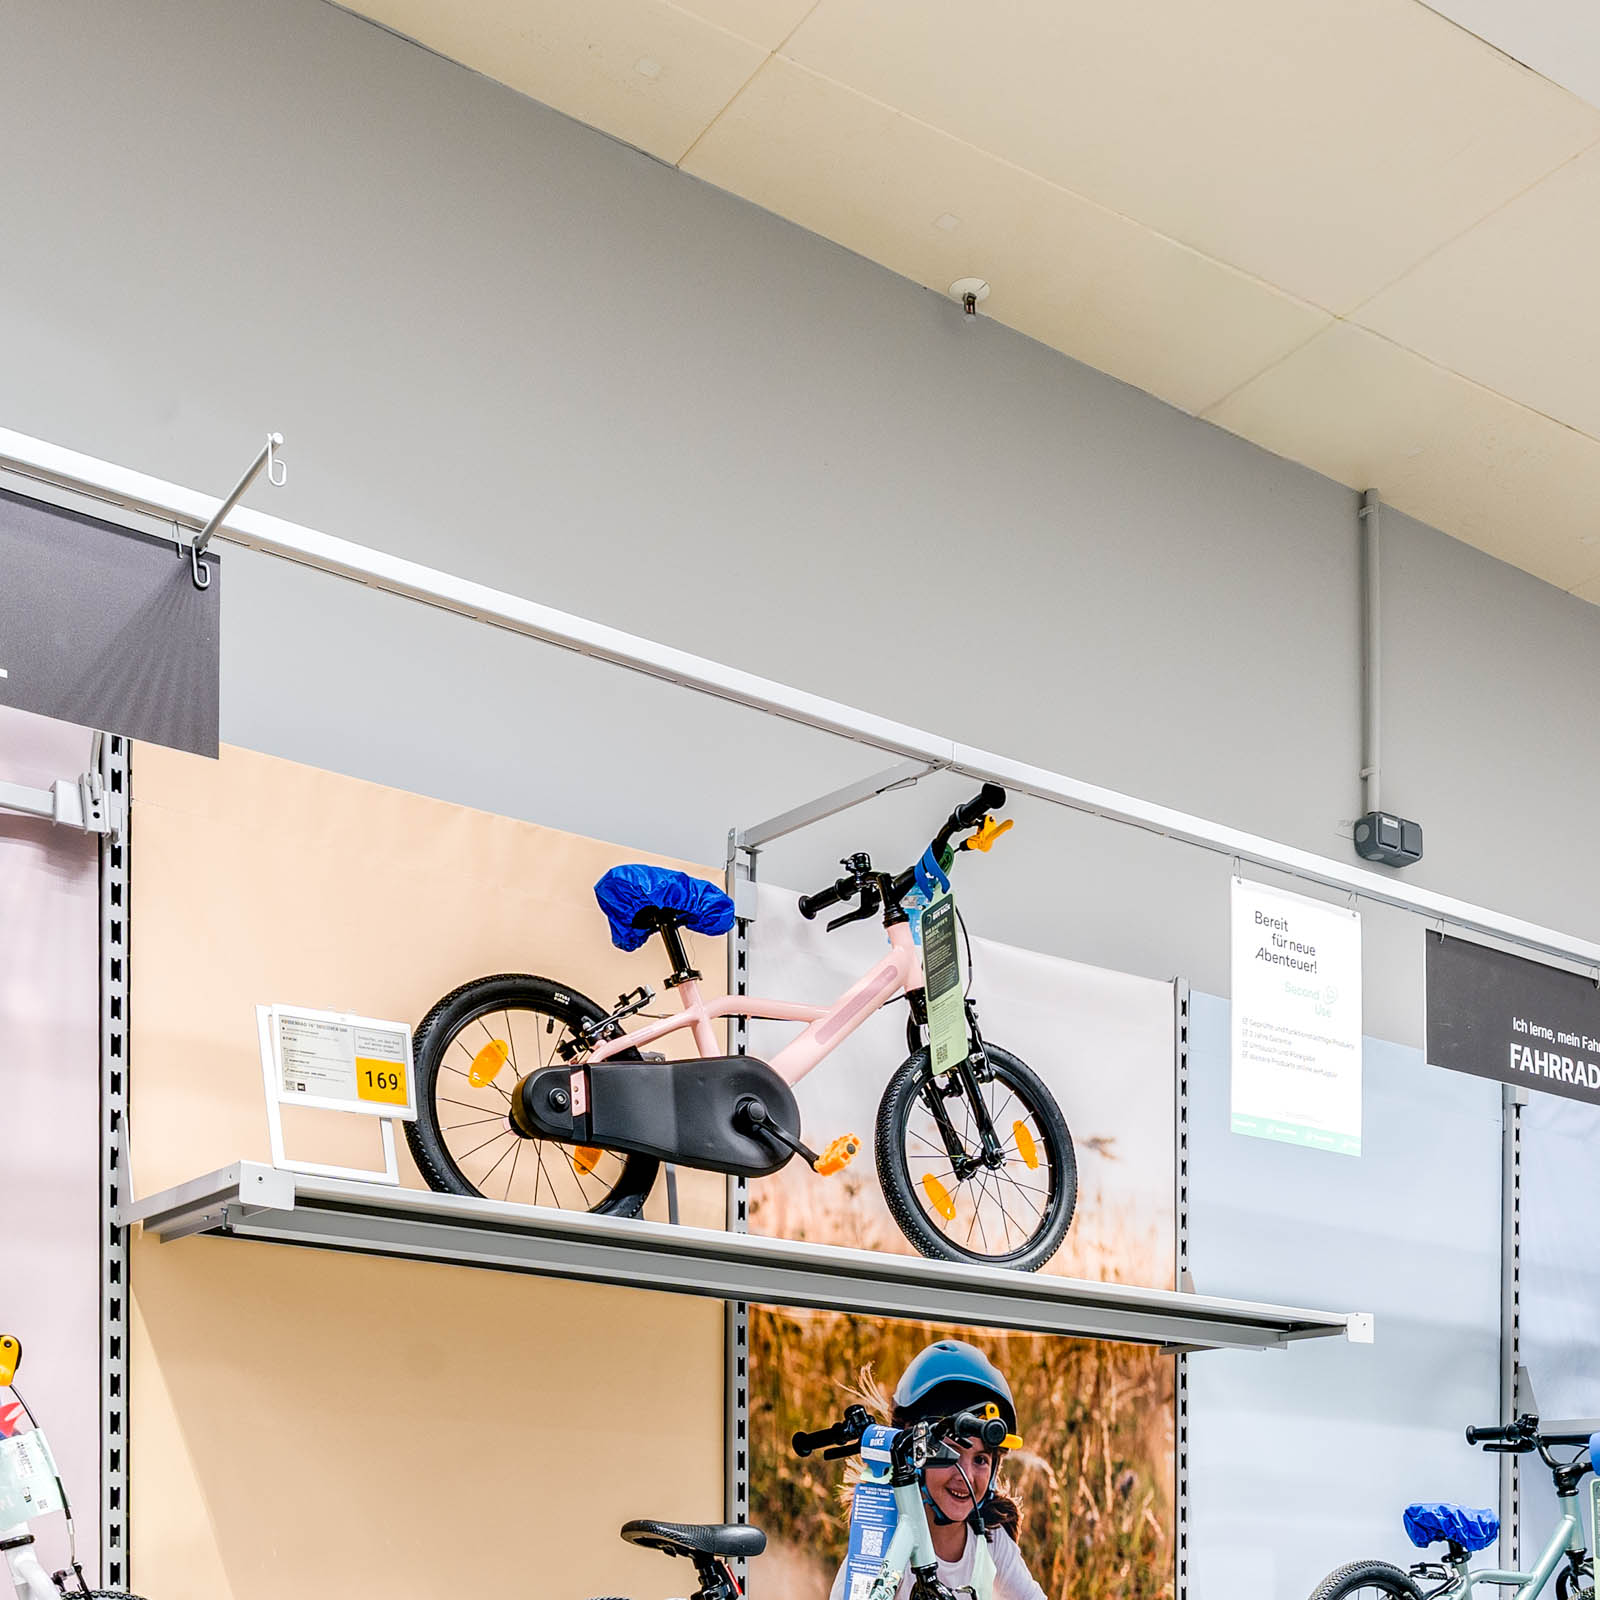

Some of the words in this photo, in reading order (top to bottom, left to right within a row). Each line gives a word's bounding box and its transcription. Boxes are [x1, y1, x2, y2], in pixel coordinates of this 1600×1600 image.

[1254, 911, 1289, 932] Bereit
[1272, 933, 1287, 949] für
[1289, 941, 1316, 956] neue
[1255, 947, 1318, 974] Abenteuer!
[1284, 982, 1320, 1000] Second
[1315, 1004, 1332, 1018] Use
[1512, 1017, 1528, 1034] Ich
[1529, 1021, 1556, 1043] lerne,
[1557, 1031, 1580, 1048] mein
[869, 1438, 885, 1447] BIKE
